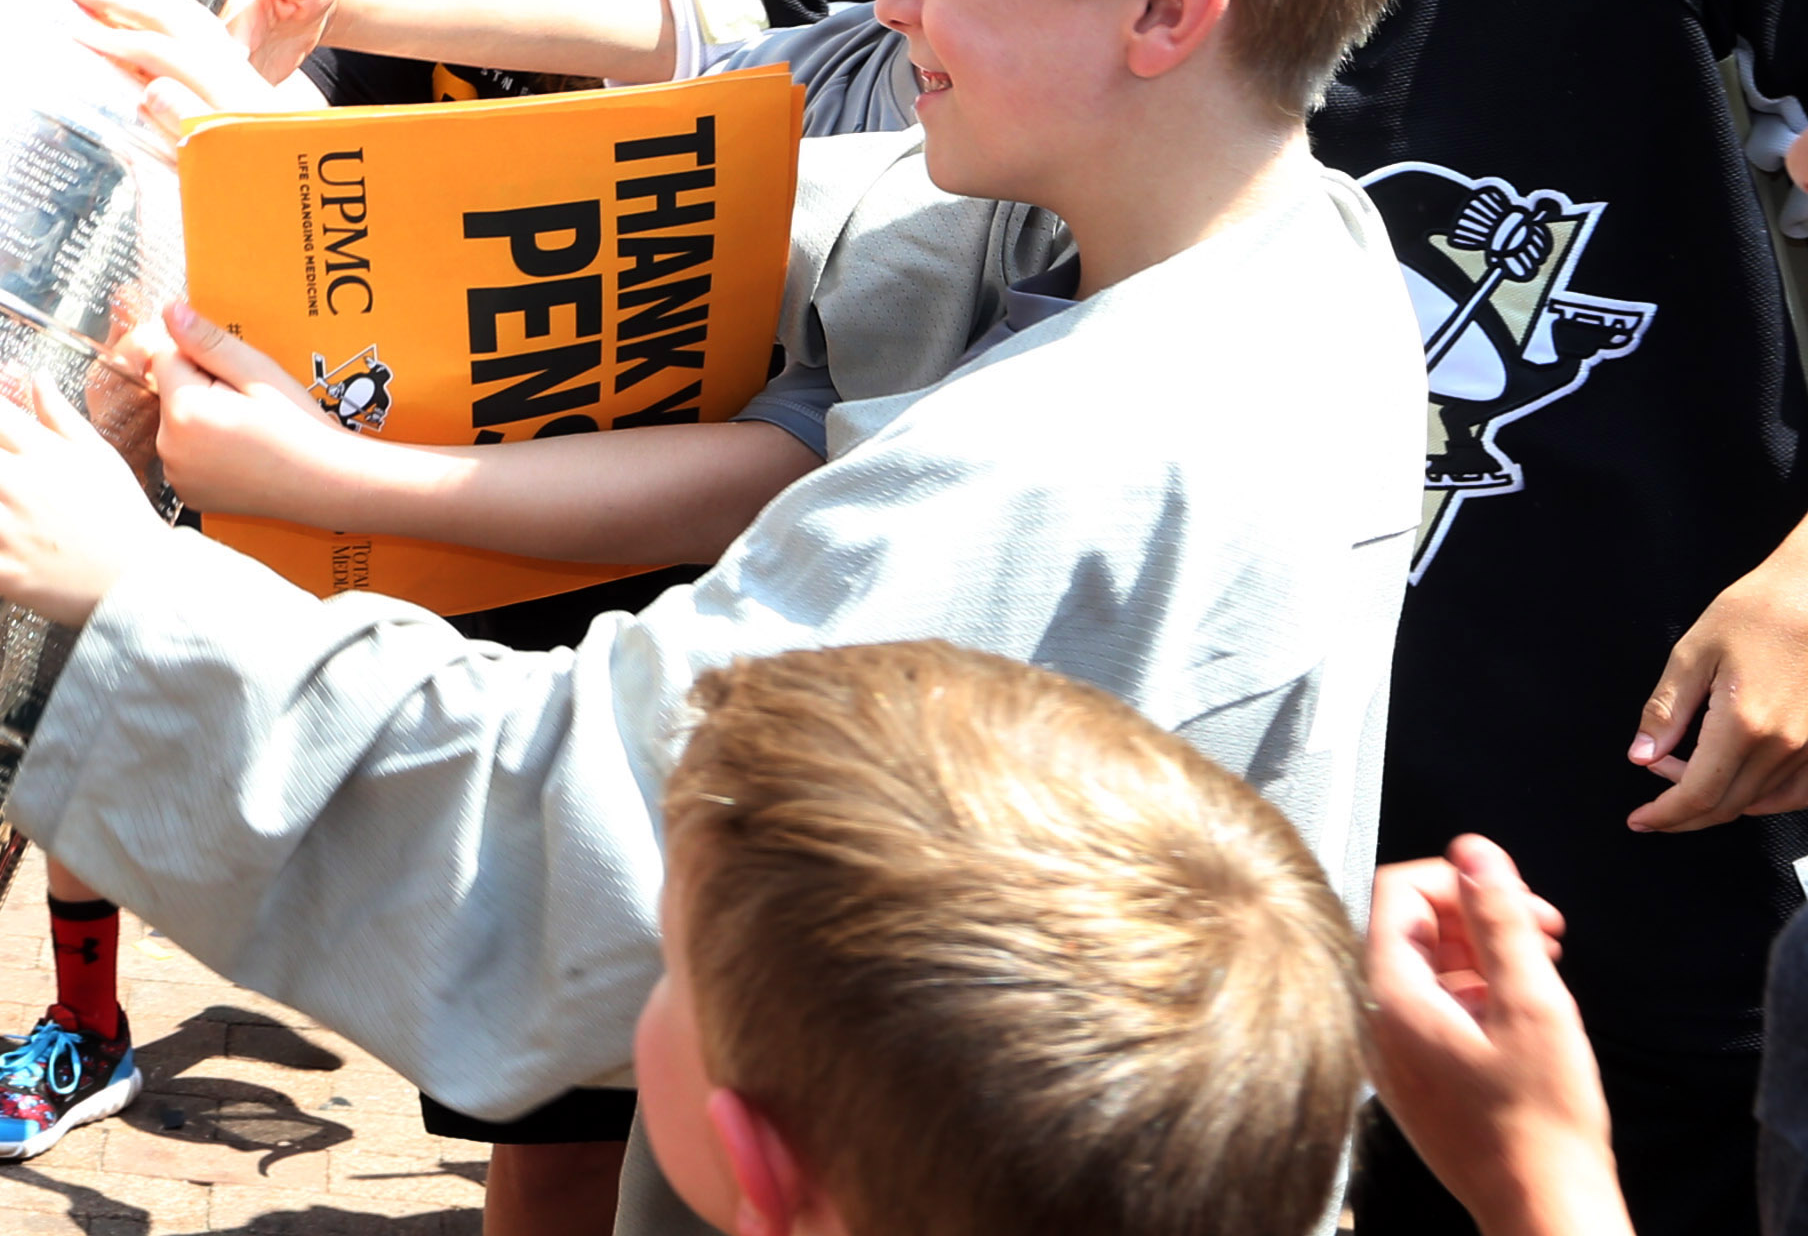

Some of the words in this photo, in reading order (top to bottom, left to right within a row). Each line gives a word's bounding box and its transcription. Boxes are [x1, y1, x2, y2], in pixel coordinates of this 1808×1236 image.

[297, 153, 310, 181] LIFE
[299, 183, 315, 253] CHANGING
[304, 254, 319, 317] MEDICINE
[317, 146, 374, 316] UPMC
[614, 114, 716, 395] THANK
[462, 198, 603, 446] PEN
